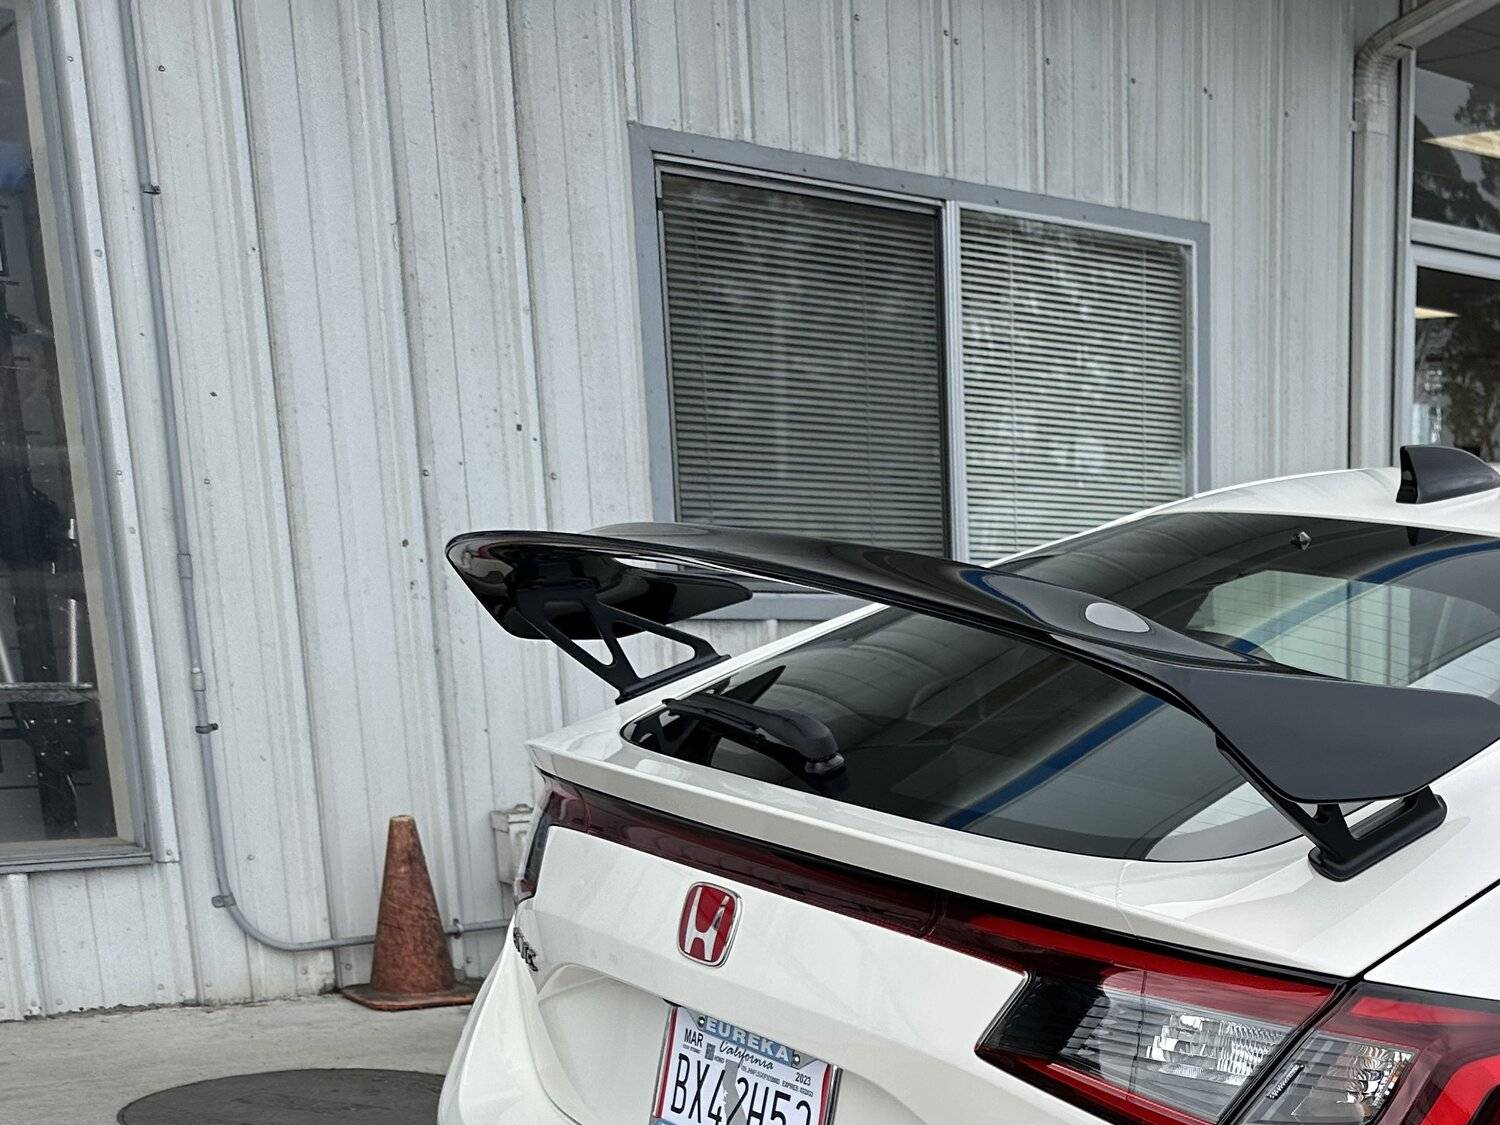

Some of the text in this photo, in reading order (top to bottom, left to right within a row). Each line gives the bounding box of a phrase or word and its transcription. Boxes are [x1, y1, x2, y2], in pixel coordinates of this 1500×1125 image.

[684, 1028, 704, 1048] MAR
[705, 1018, 789, 1062] EUREKA
[719, 1040, 774, 1069] California
[795, 1072, 811, 1087] 2023
